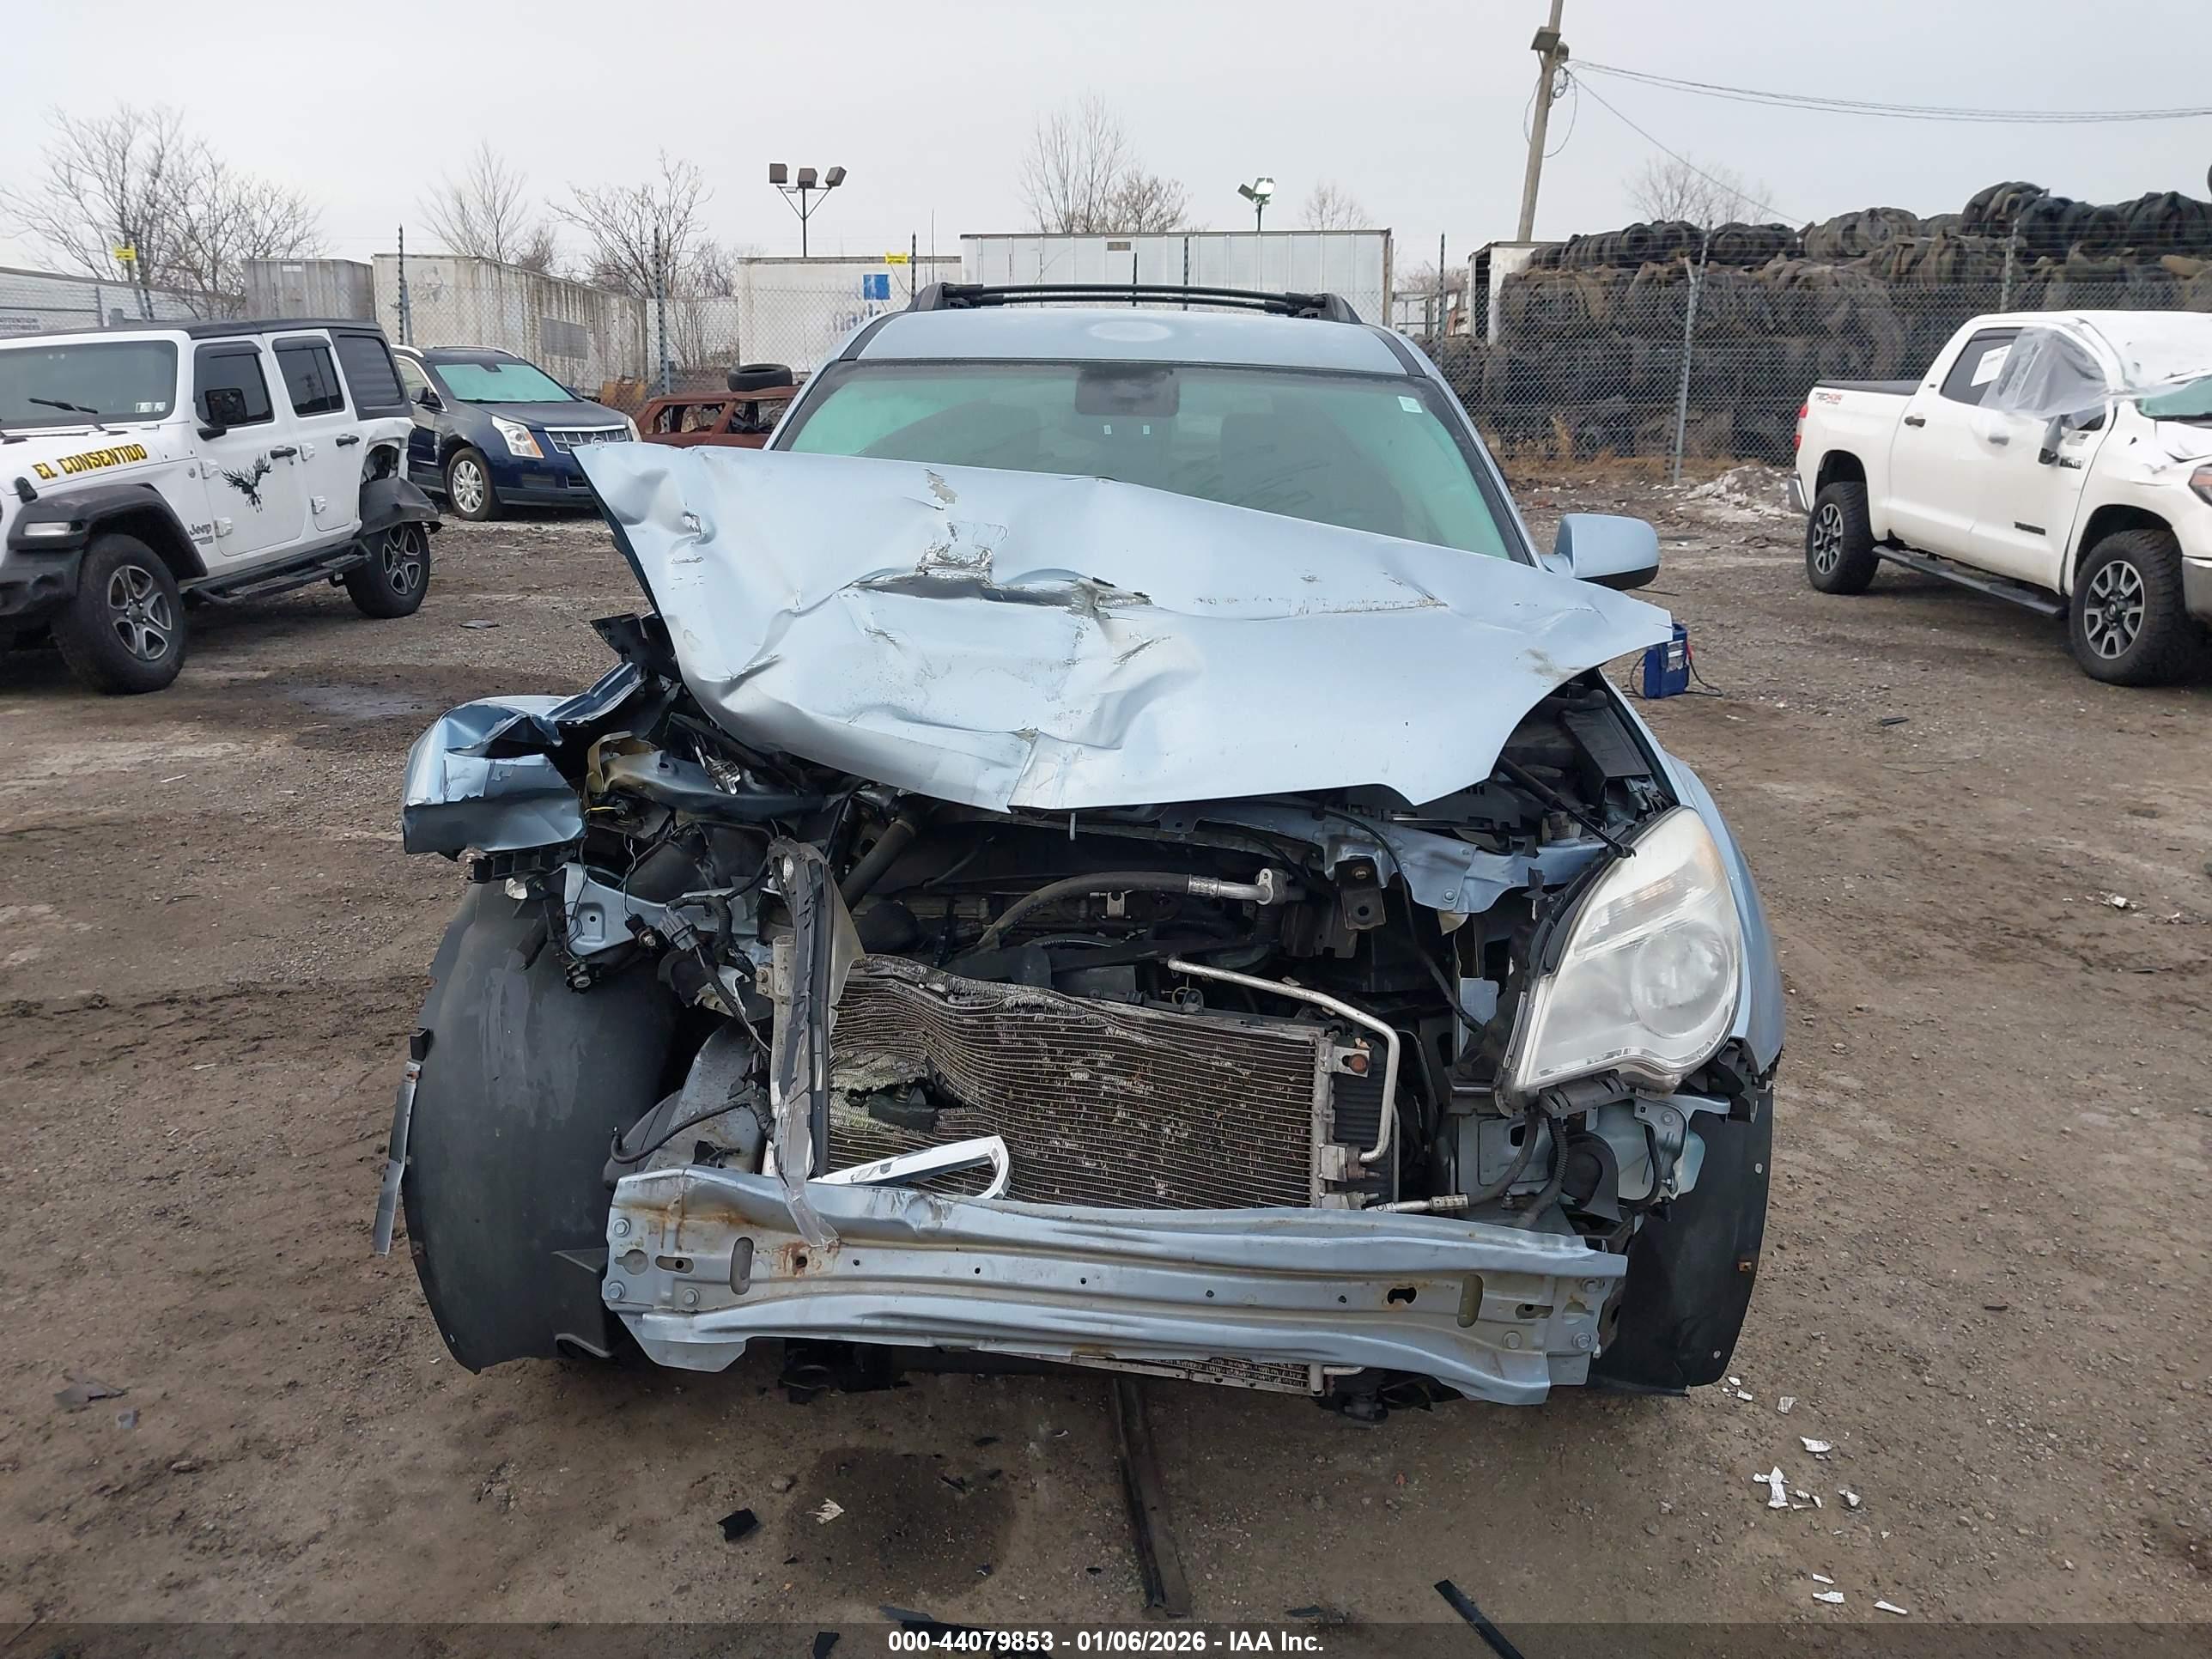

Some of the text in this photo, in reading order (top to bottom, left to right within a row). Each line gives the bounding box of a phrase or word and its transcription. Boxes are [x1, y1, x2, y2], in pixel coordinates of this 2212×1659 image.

[32, 443, 148, 479] EL CONSENTIDO
[189, 523, 212, 536] Jeep
